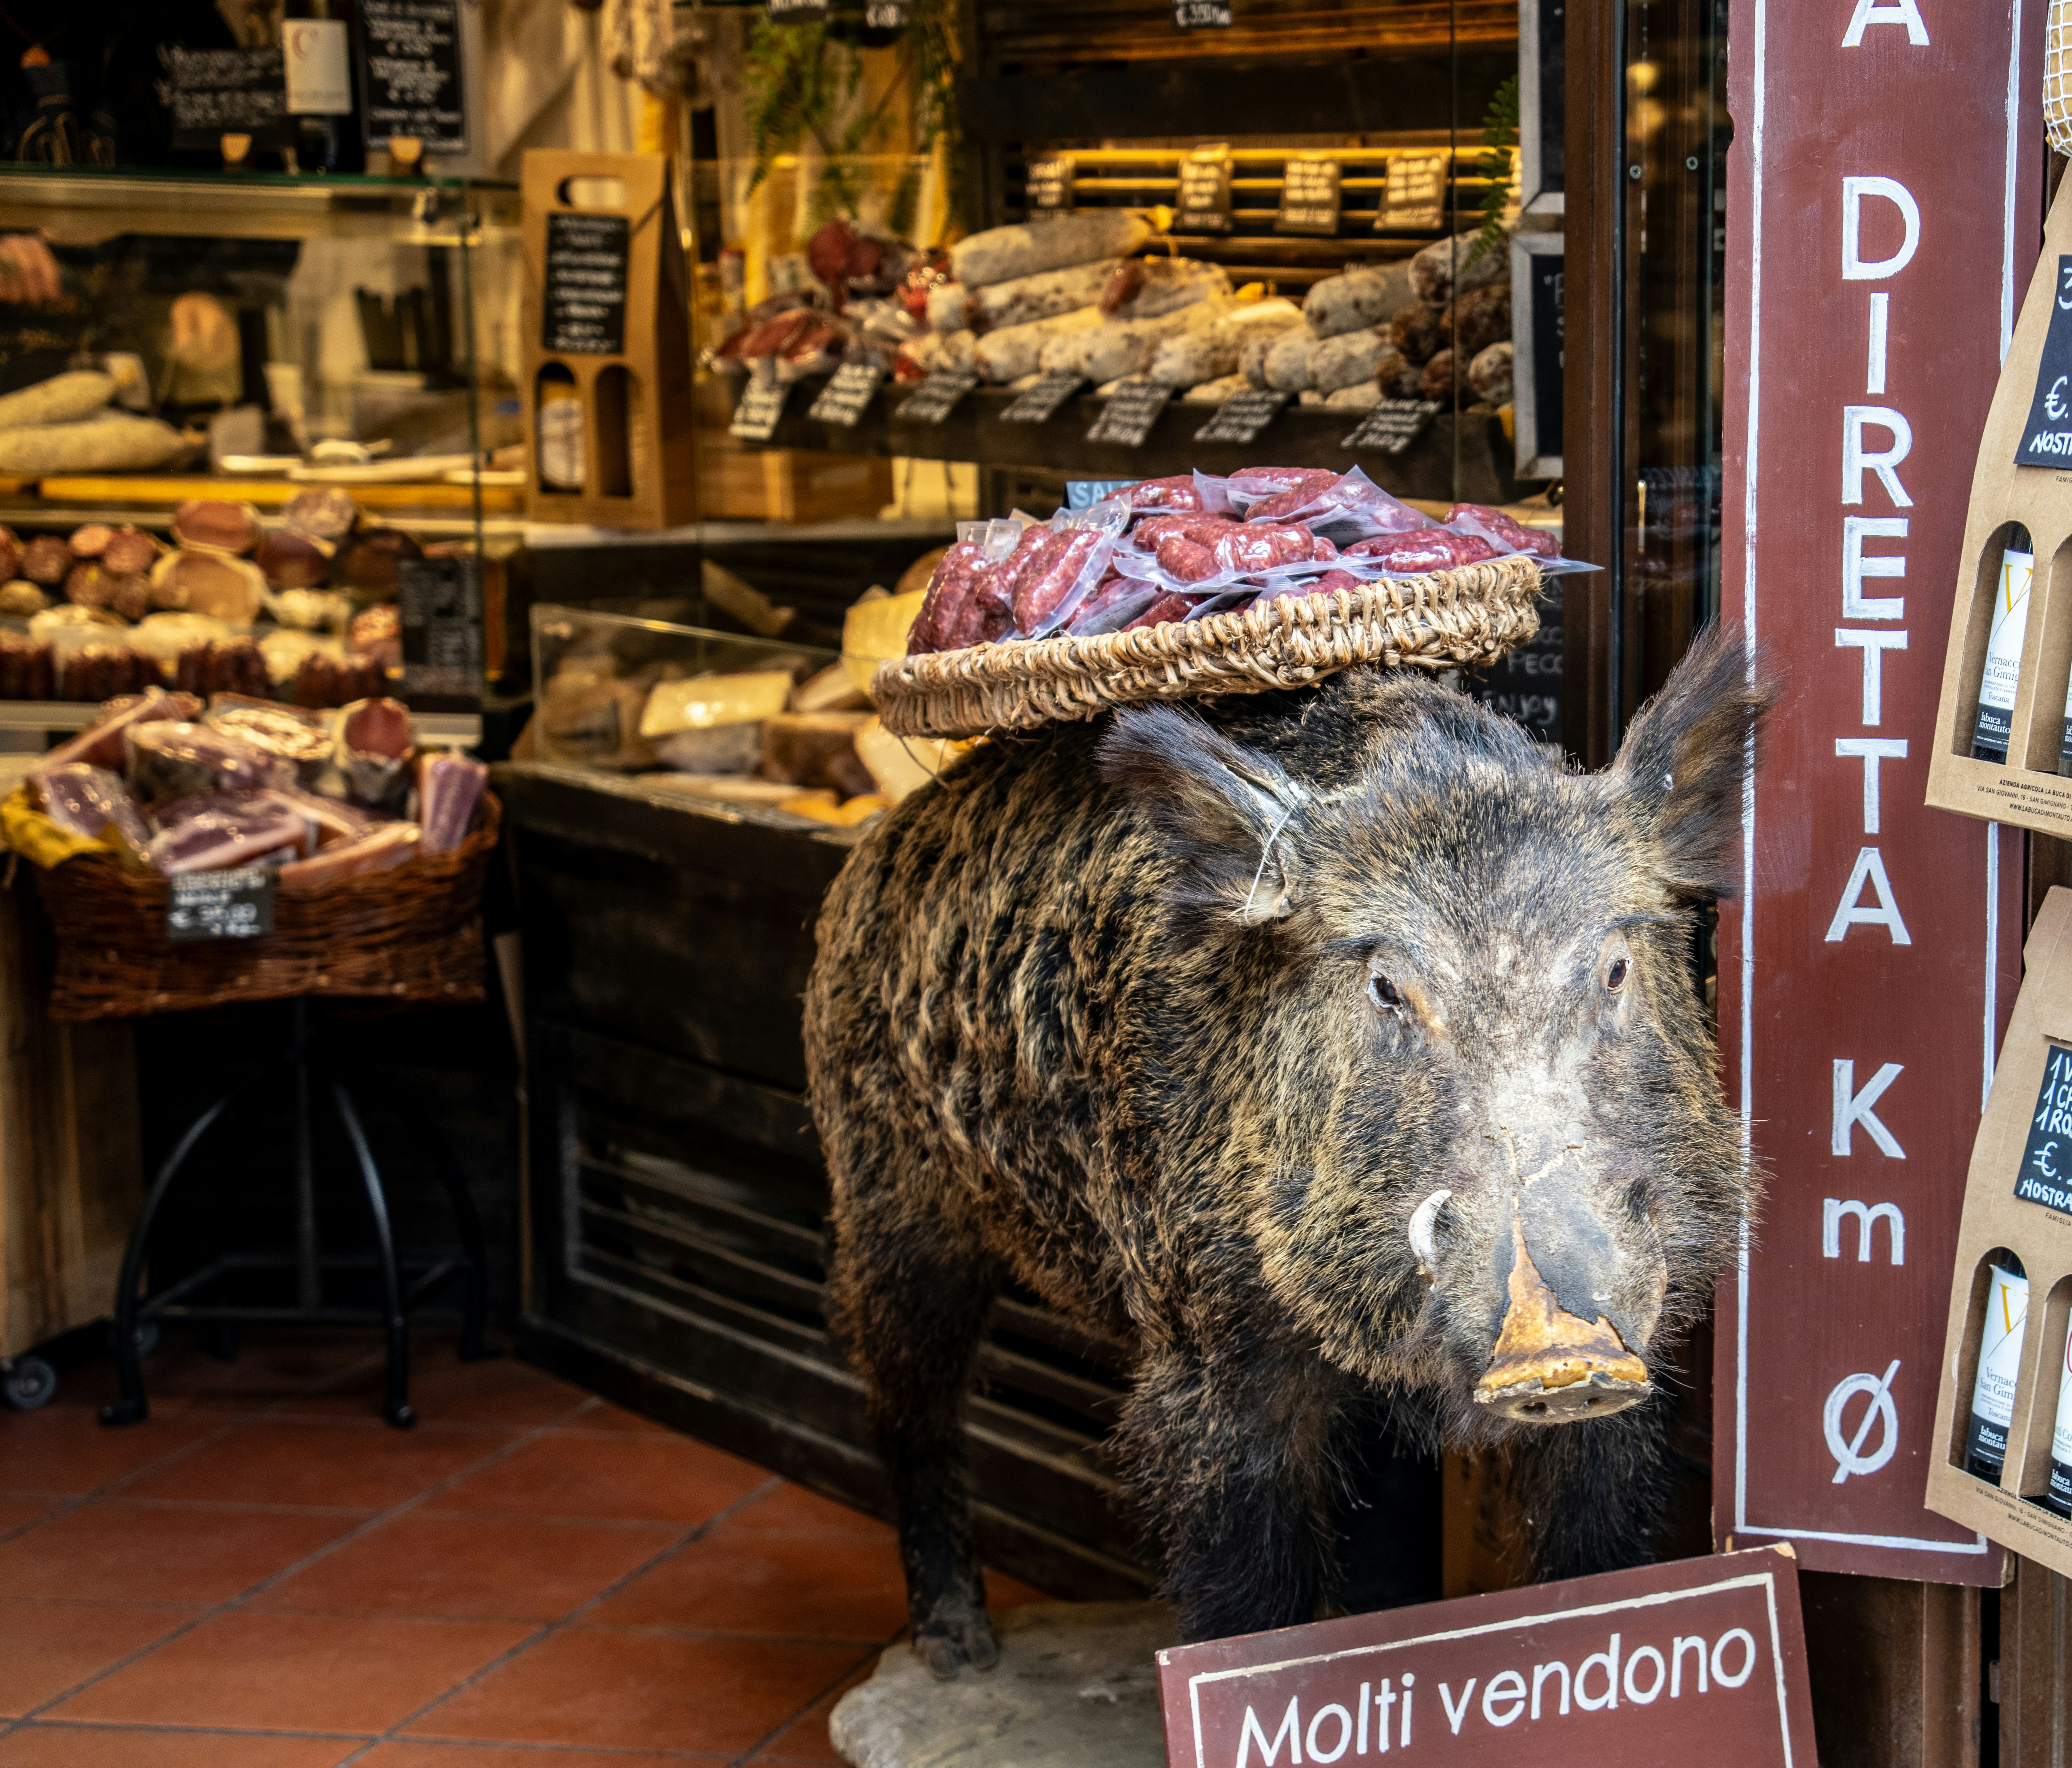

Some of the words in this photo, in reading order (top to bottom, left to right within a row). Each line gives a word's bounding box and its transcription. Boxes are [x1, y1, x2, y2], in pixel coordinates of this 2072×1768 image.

[1824, 176, 1921, 945] DIRETTA
[1988, 691, 2009, 703] Toscana
[1979, 721, 2011, 734] montauto
[1999, 779, 2019, 788] AZIENDA
[2020, 783, 2044, 793] AGRICOLA
[2052, 790, 2065, 798] BUCA
[2040, 798, 2066, 809] GIMIGNANO
[2045, 1212, 2071, 1227] FAMIGLIA
[1985, 1491, 1994, 1499] SAN
[2028, 1511, 2037, 1520] SAN
[2038, 1516, 2065, 1533] GIMIGNANO
[1236, 1672, 1415, 1768] Molti
[1438, 1627, 1756, 1736] vendono
